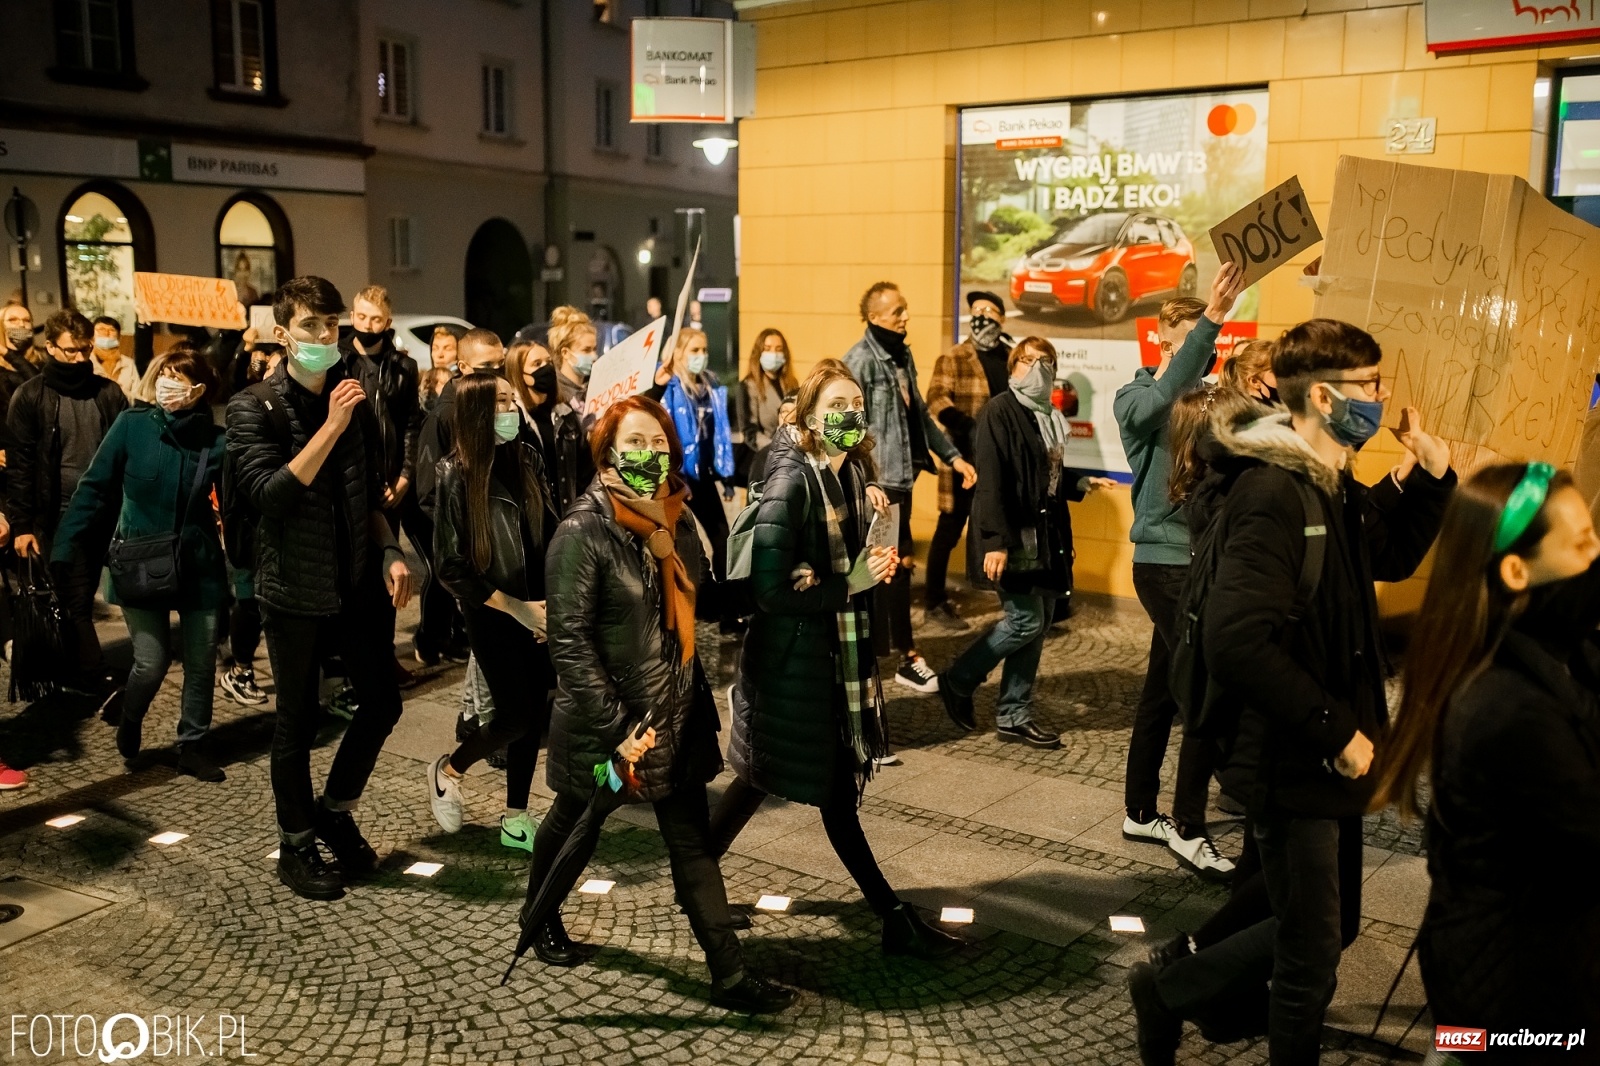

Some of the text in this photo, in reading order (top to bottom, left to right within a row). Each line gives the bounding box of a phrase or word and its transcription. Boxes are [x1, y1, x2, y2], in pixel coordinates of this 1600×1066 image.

[645, 50, 714, 62] BANKOMAT
[664, 75, 687, 85] Bank
[998, 117, 1063, 133] Bank Pekao
[1389, 122, 1433, 152] 24
[187, 155, 279, 178] BNP PARIBAS
[1014, 151, 1208, 184] WYGRAJ BMW i3
[1042, 178, 1182, 215] I BĄDŹ EKO!
[1221, 191, 1309, 274] DOŚĆ!
[157, 275, 209, 292] ODDAMY
